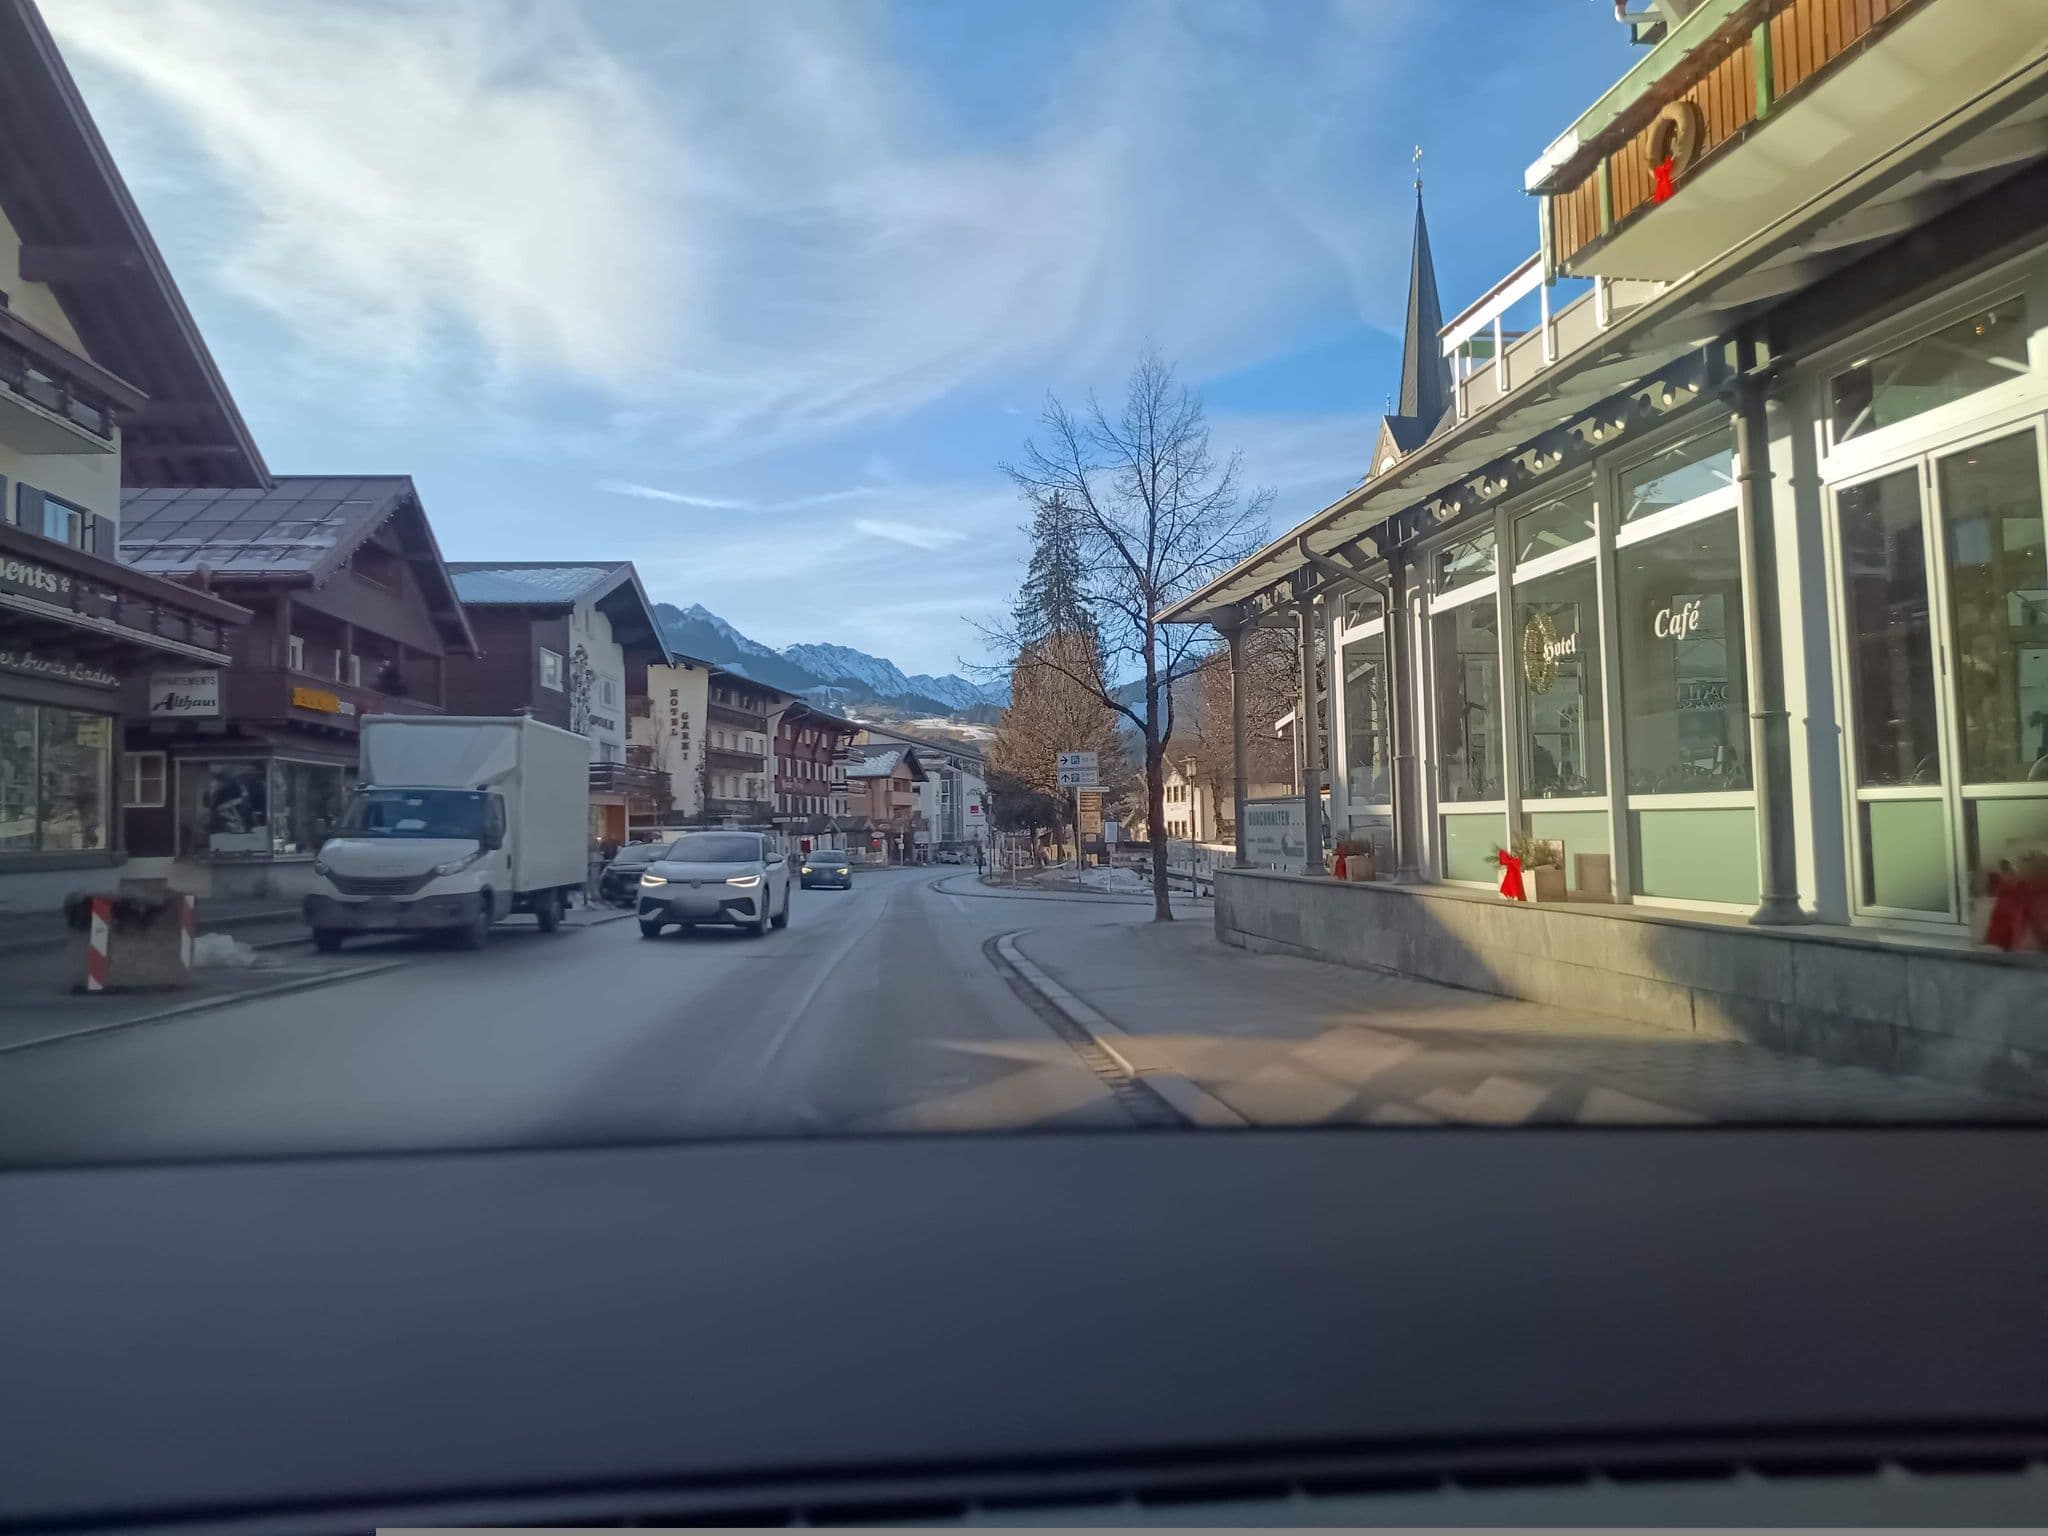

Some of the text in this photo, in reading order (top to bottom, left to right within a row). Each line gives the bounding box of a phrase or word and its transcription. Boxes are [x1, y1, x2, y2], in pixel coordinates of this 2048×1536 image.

[1654, 600, 1700, 640] Café
[1543, 633, 1577, 664] Hotel
[152, 692, 216, 711] Althaus
[670, 689, 679, 736] HOTEL
[681, 712, 690, 760] GARNI
